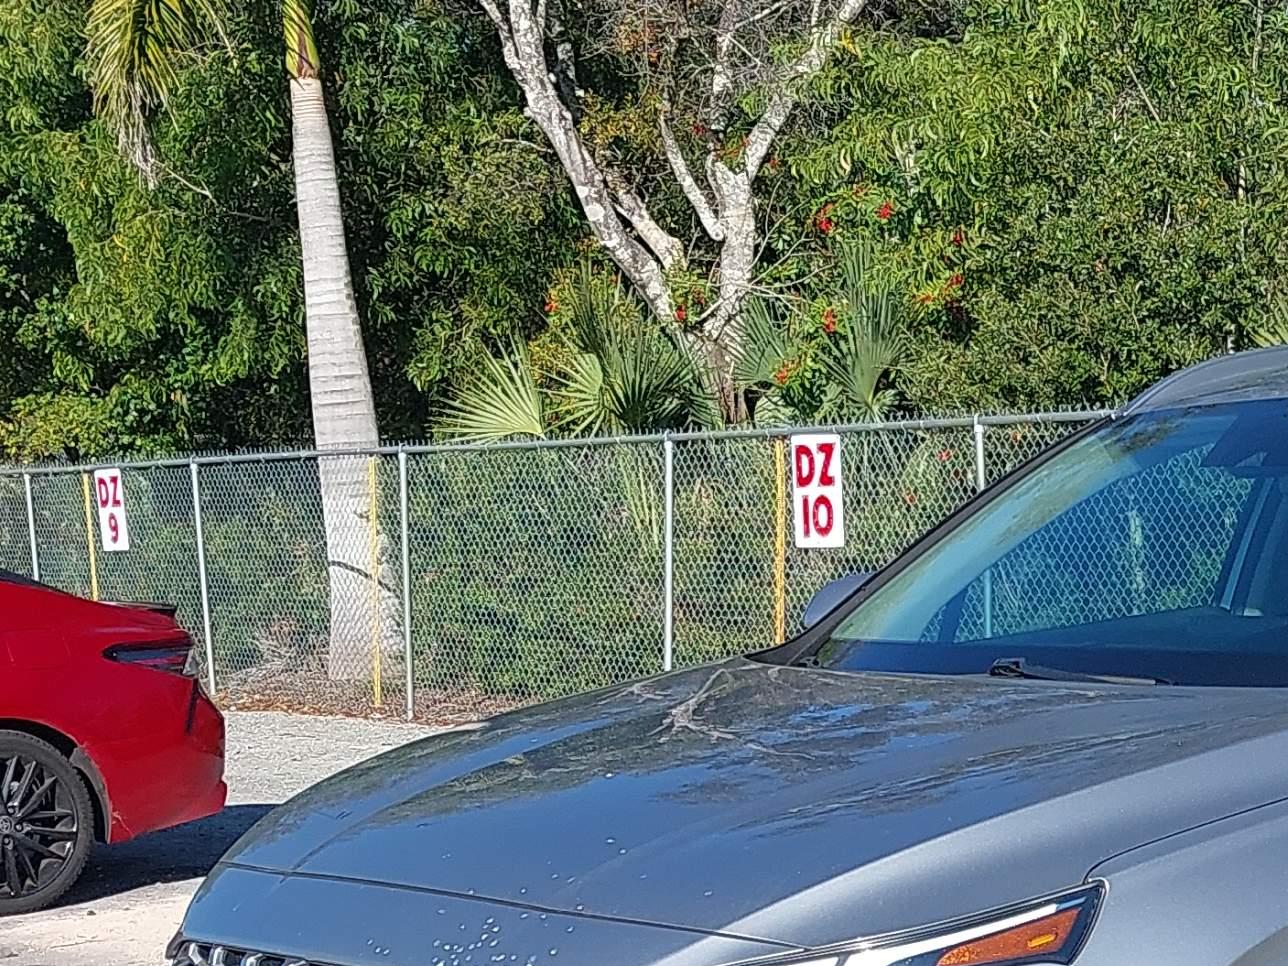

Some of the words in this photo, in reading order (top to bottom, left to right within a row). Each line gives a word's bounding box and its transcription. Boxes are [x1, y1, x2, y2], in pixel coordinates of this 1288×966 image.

[795, 442, 836, 488] DZ
[97, 476, 122, 508] DZ
[108, 512, 119, 544] 9
[802, 494, 834, 538] 10
